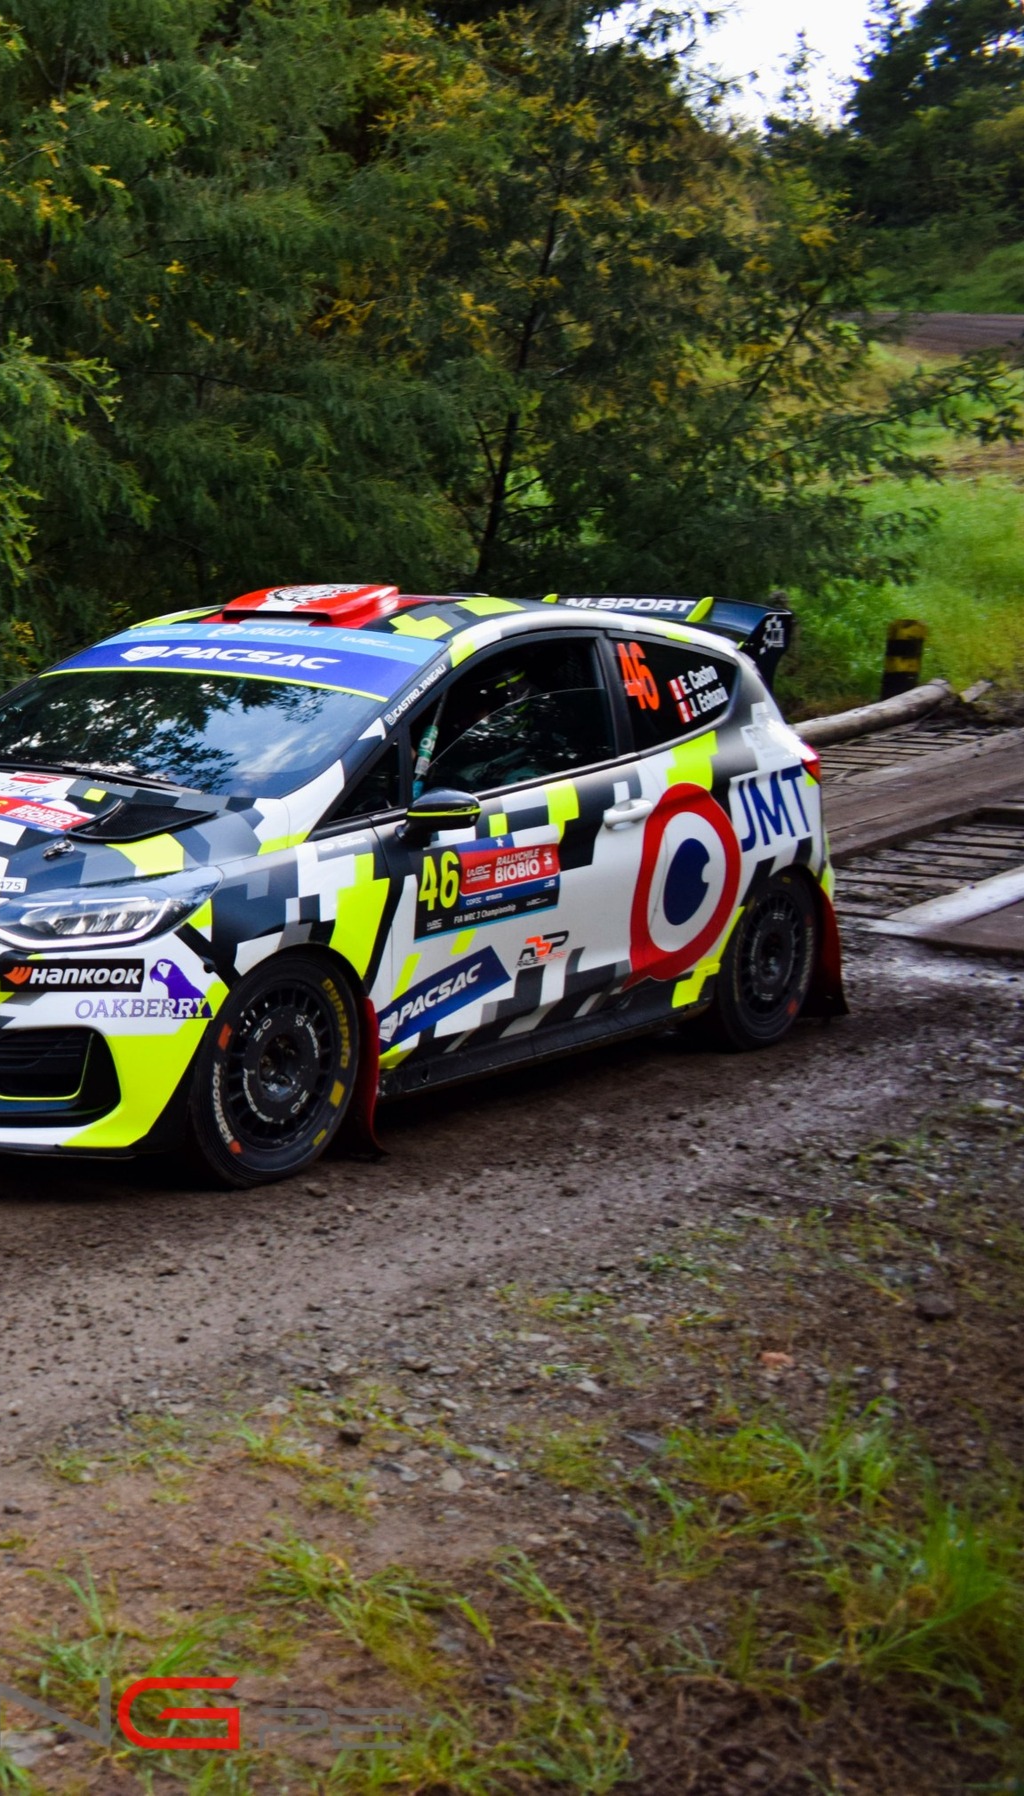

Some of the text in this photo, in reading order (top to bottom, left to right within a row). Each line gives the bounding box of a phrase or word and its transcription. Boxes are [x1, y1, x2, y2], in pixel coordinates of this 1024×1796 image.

[566, 597, 697, 613] M-SPORT
[162, 646, 342, 670] PACSAC
[617, 641, 660, 711] 46
[678, 665, 718, 695] E. Castro
[689, 697, 701, 717] J.
[738, 764, 811, 853] JMT
[419, 850, 460, 911] 46
[75, 997, 214, 1020] OAKBERRY
[398, 962, 483, 1026] PACSAC
